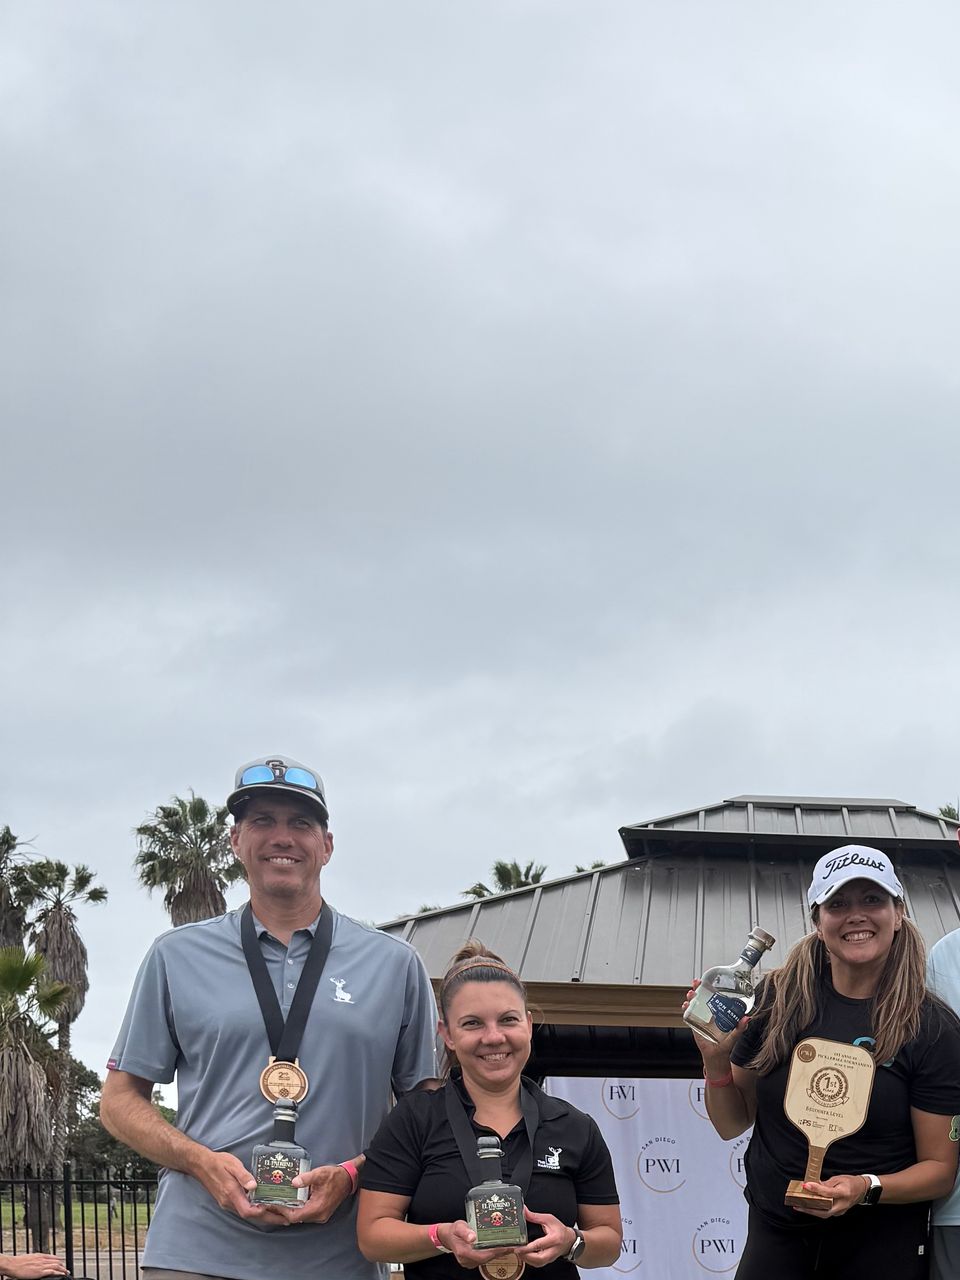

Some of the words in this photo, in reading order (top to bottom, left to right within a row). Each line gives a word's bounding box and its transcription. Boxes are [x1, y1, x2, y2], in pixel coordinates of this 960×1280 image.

[822, 852, 886, 880] Titleist
[824, 1077, 837, 1089] 1st
[642, 1140, 653, 1150] SAN
[655, 1136, 676, 1145] DIEGO
[733, 1139, 744, 1150] SAN
[646, 1158, 680, 1173] PWI
[697, 1220, 708, 1231] SAN
[701, 1239, 735, 1254] PWI
